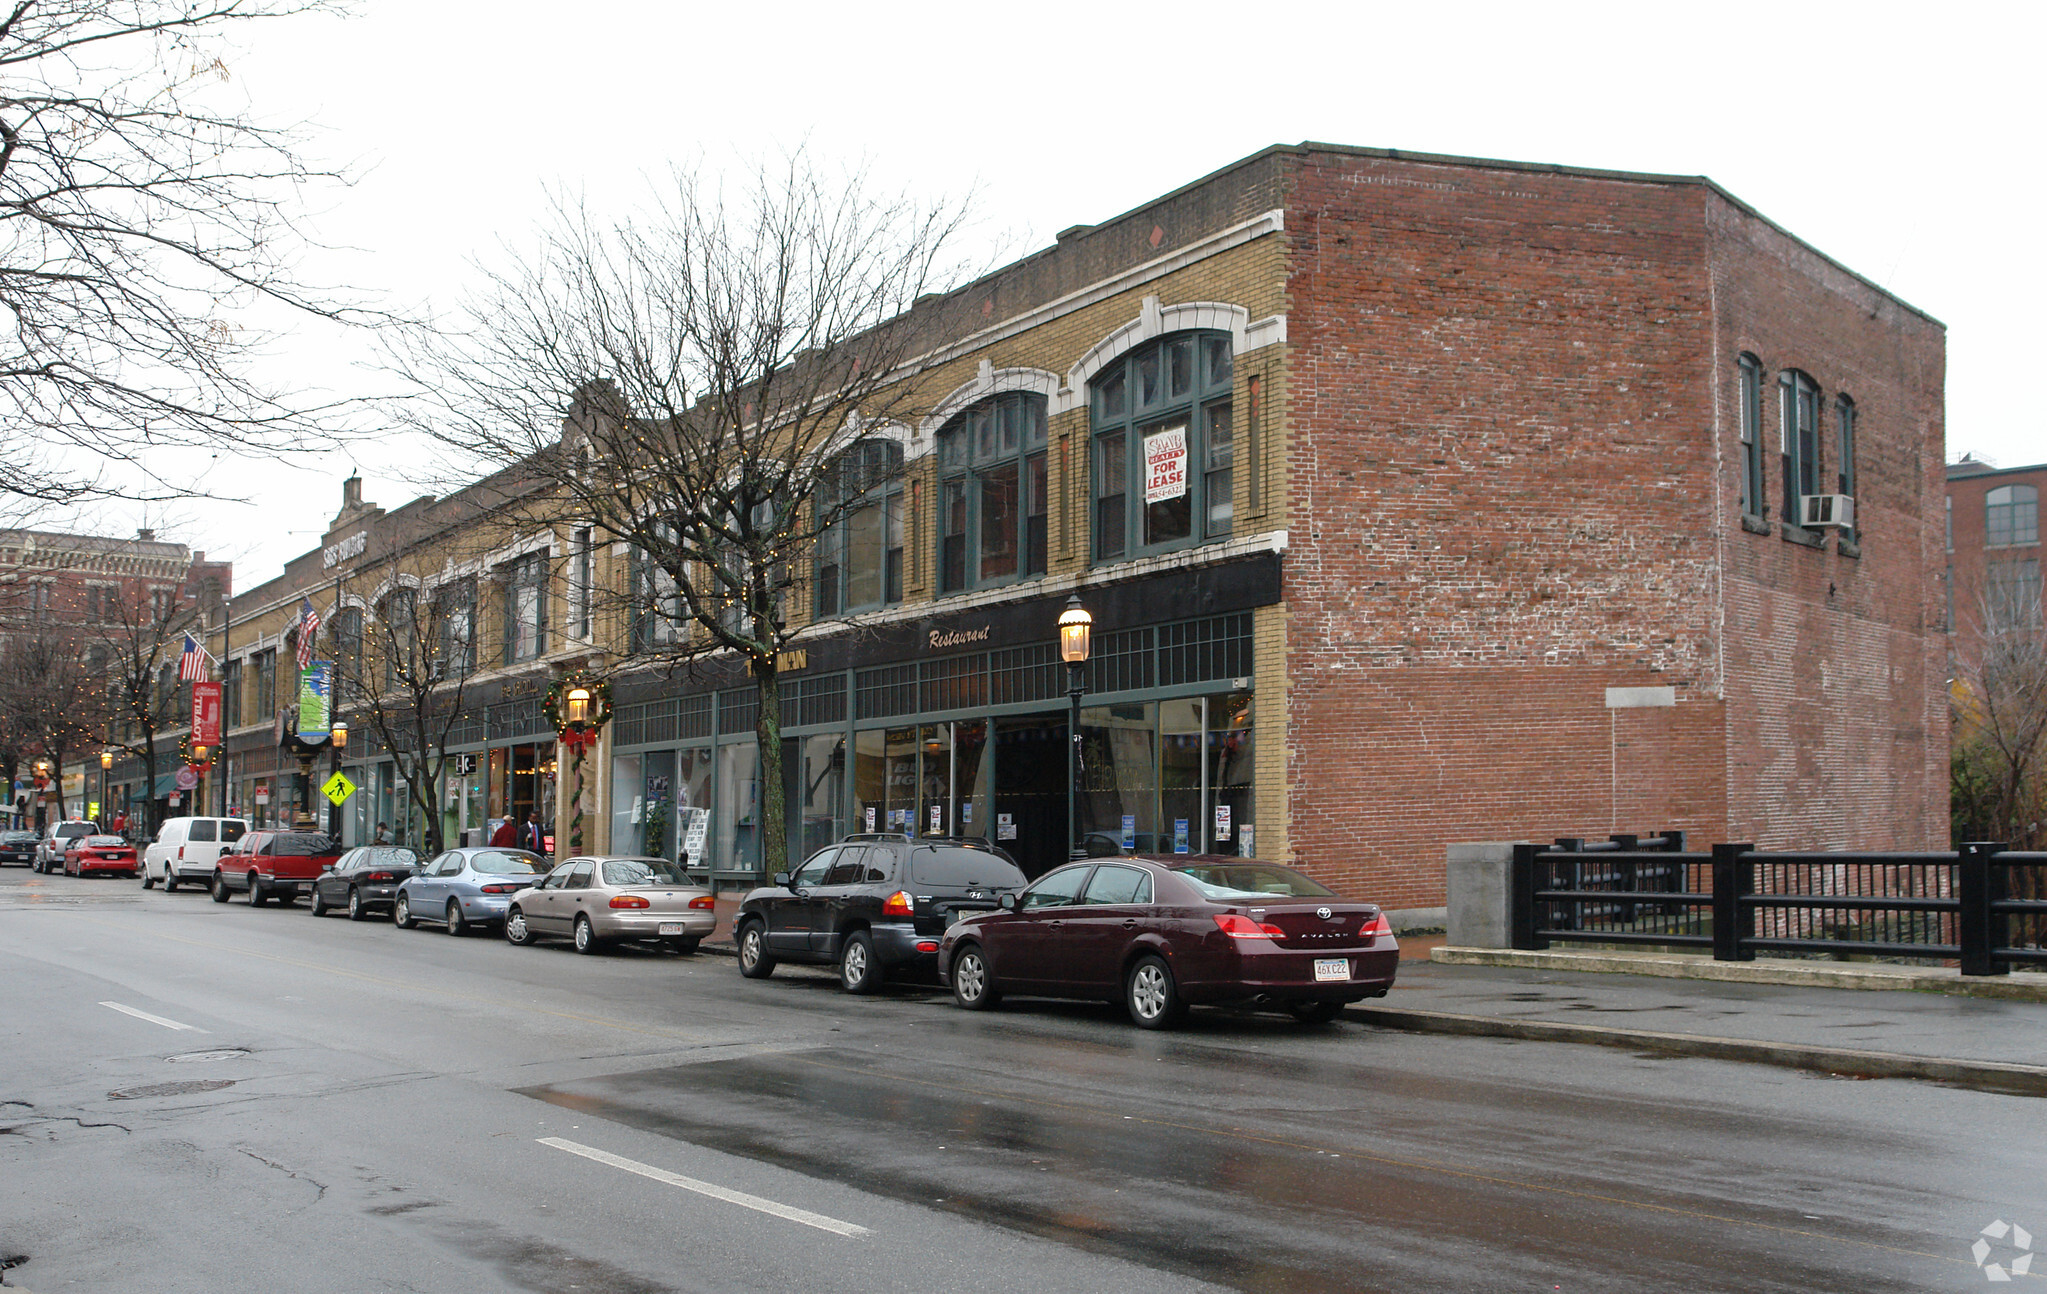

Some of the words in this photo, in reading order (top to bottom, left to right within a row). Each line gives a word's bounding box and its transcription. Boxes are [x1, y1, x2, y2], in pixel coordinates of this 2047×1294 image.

[1149, 434, 1183, 456] SAAB
[1150, 450, 1183, 463] REALTY
[1154, 460, 1177, 475] FOR
[1148, 470, 1183, 490] LEASE
[929, 624, 990, 648] Restaurant
[192, 696, 203, 742] LOWELL
[1317, 964, 1331, 975] 46X
[1332, 963, 1347, 974] C22
